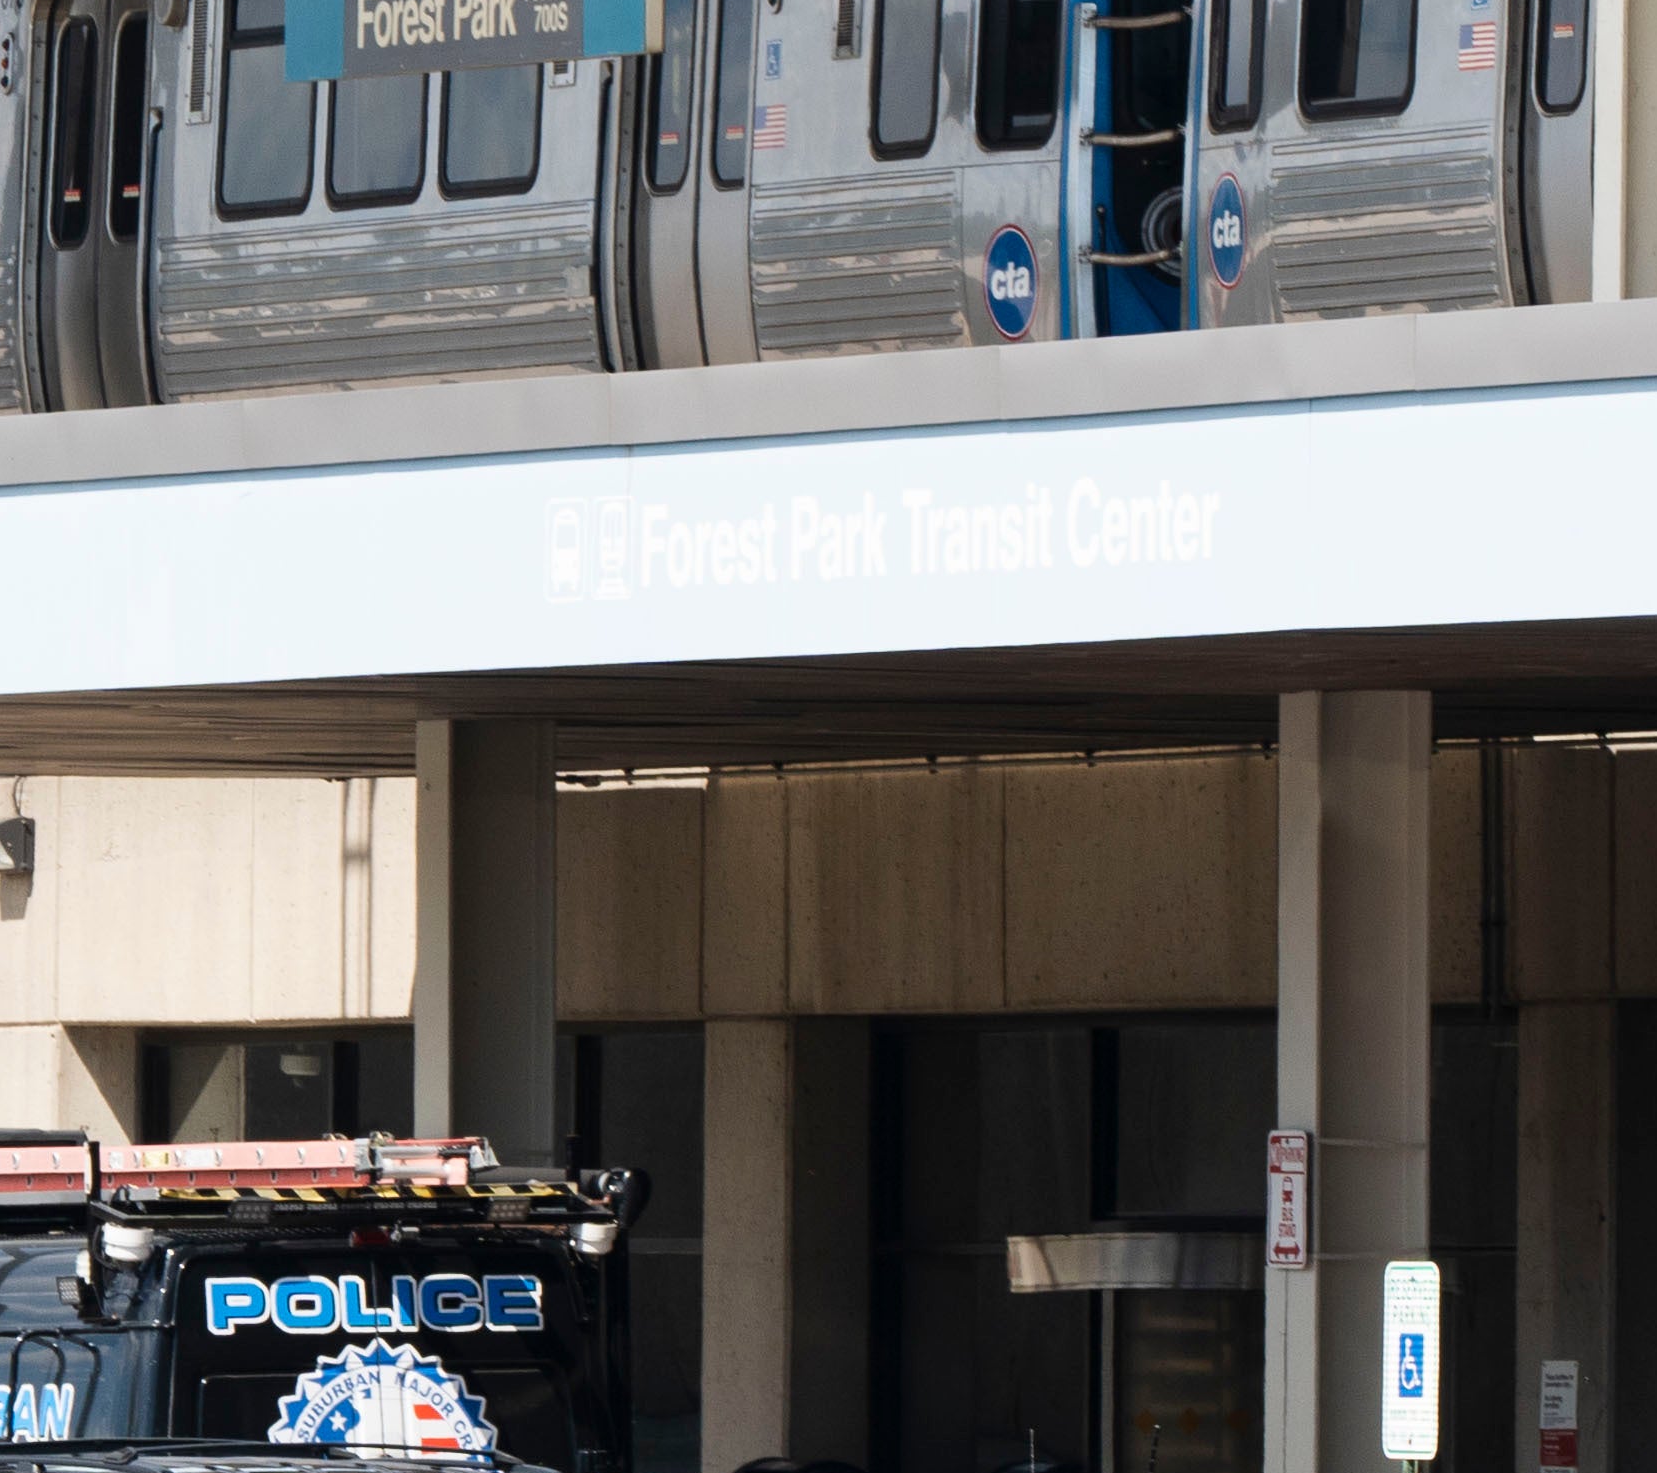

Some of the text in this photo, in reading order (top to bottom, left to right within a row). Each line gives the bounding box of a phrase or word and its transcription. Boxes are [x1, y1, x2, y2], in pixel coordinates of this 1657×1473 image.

[534, 2, 569, 34] 700S
[1213, 210, 1241, 250] cta
[990, 259, 1031, 301] cta
[640, 476, 1220, 590] Forest Park Transit Center
[204, 1273, 544, 1336] POLICE
[296, 1369, 381, 1443] SUBURBAN
[393, 1369, 455, 1421] MAJOR
